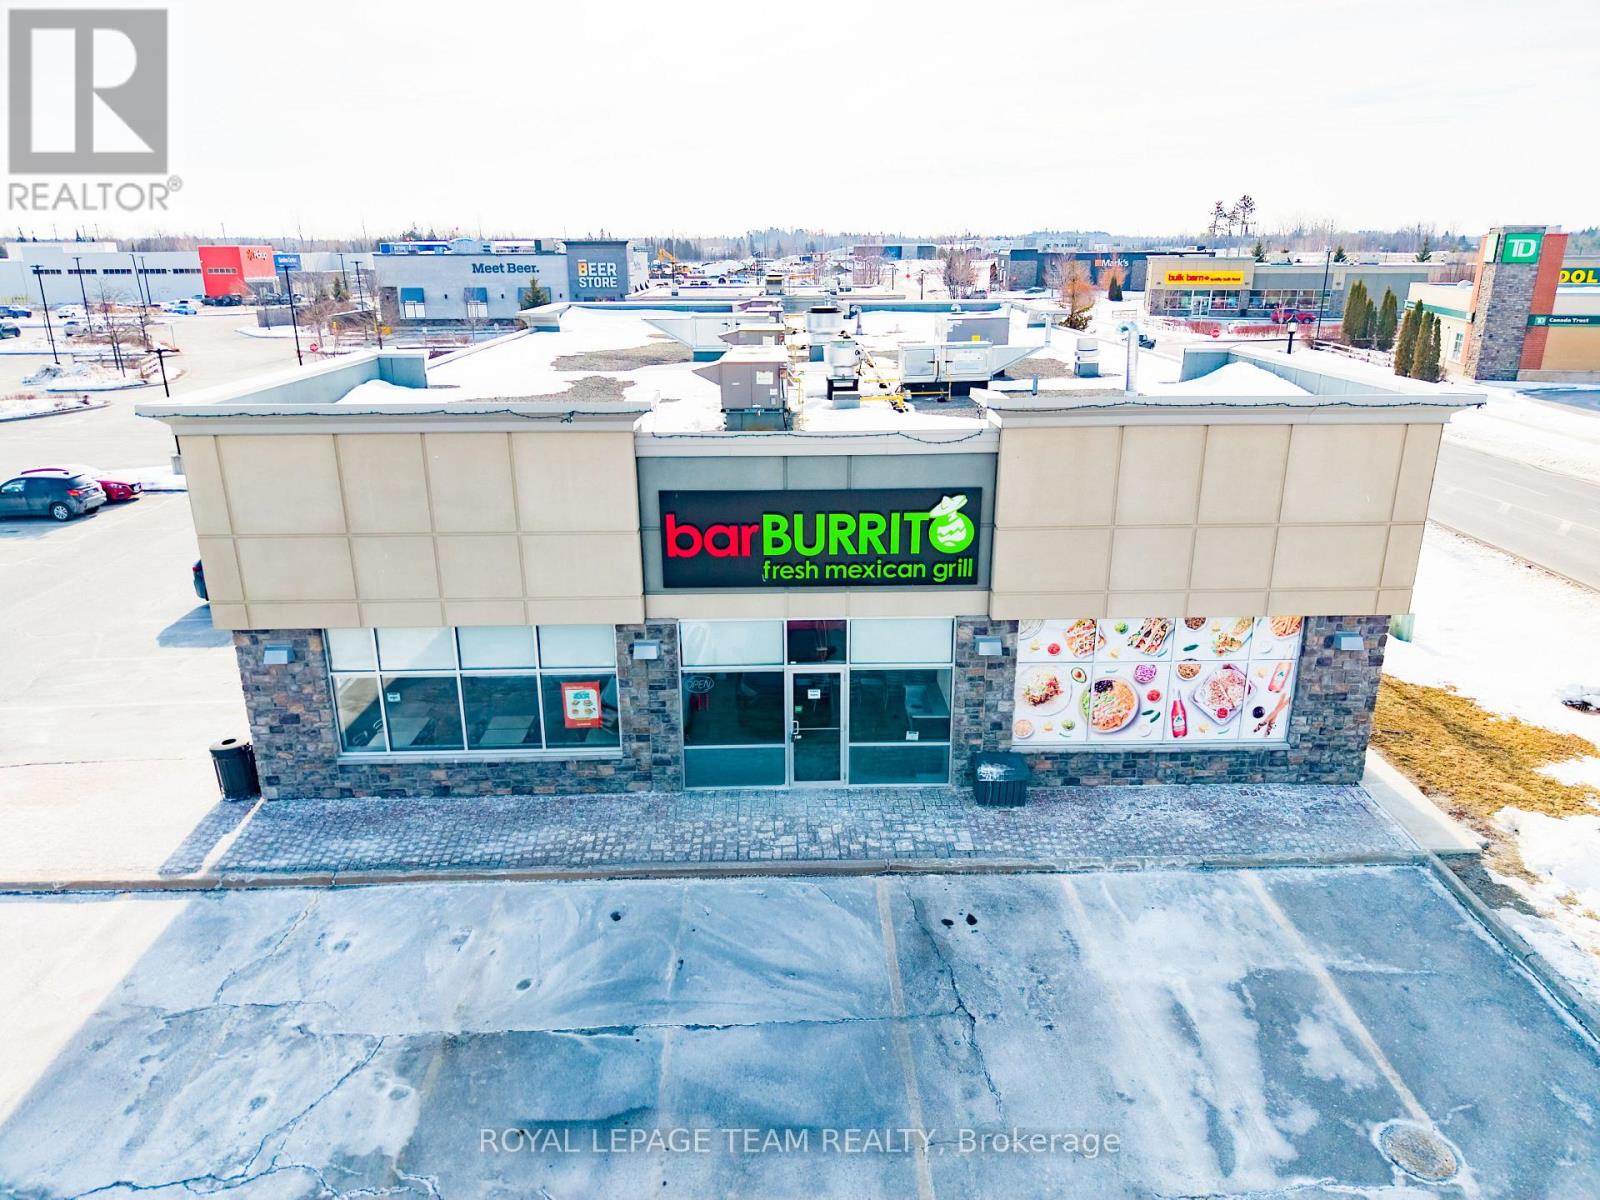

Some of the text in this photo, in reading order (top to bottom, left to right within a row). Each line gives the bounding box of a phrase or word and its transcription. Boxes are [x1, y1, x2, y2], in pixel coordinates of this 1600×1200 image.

[1508, 239, 1537, 257] TD
[472, 263, 540, 274] Meet Beer.
[578, 260, 617, 276] BEER
[1102, 259, 1129, 267] Mark's
[579, 277, 617, 288] STORE
[1168, 273, 1204, 281] bulk barn
[1535, 316, 1546, 325] TD
[762, 558, 973, 582] fresh mexican grill
